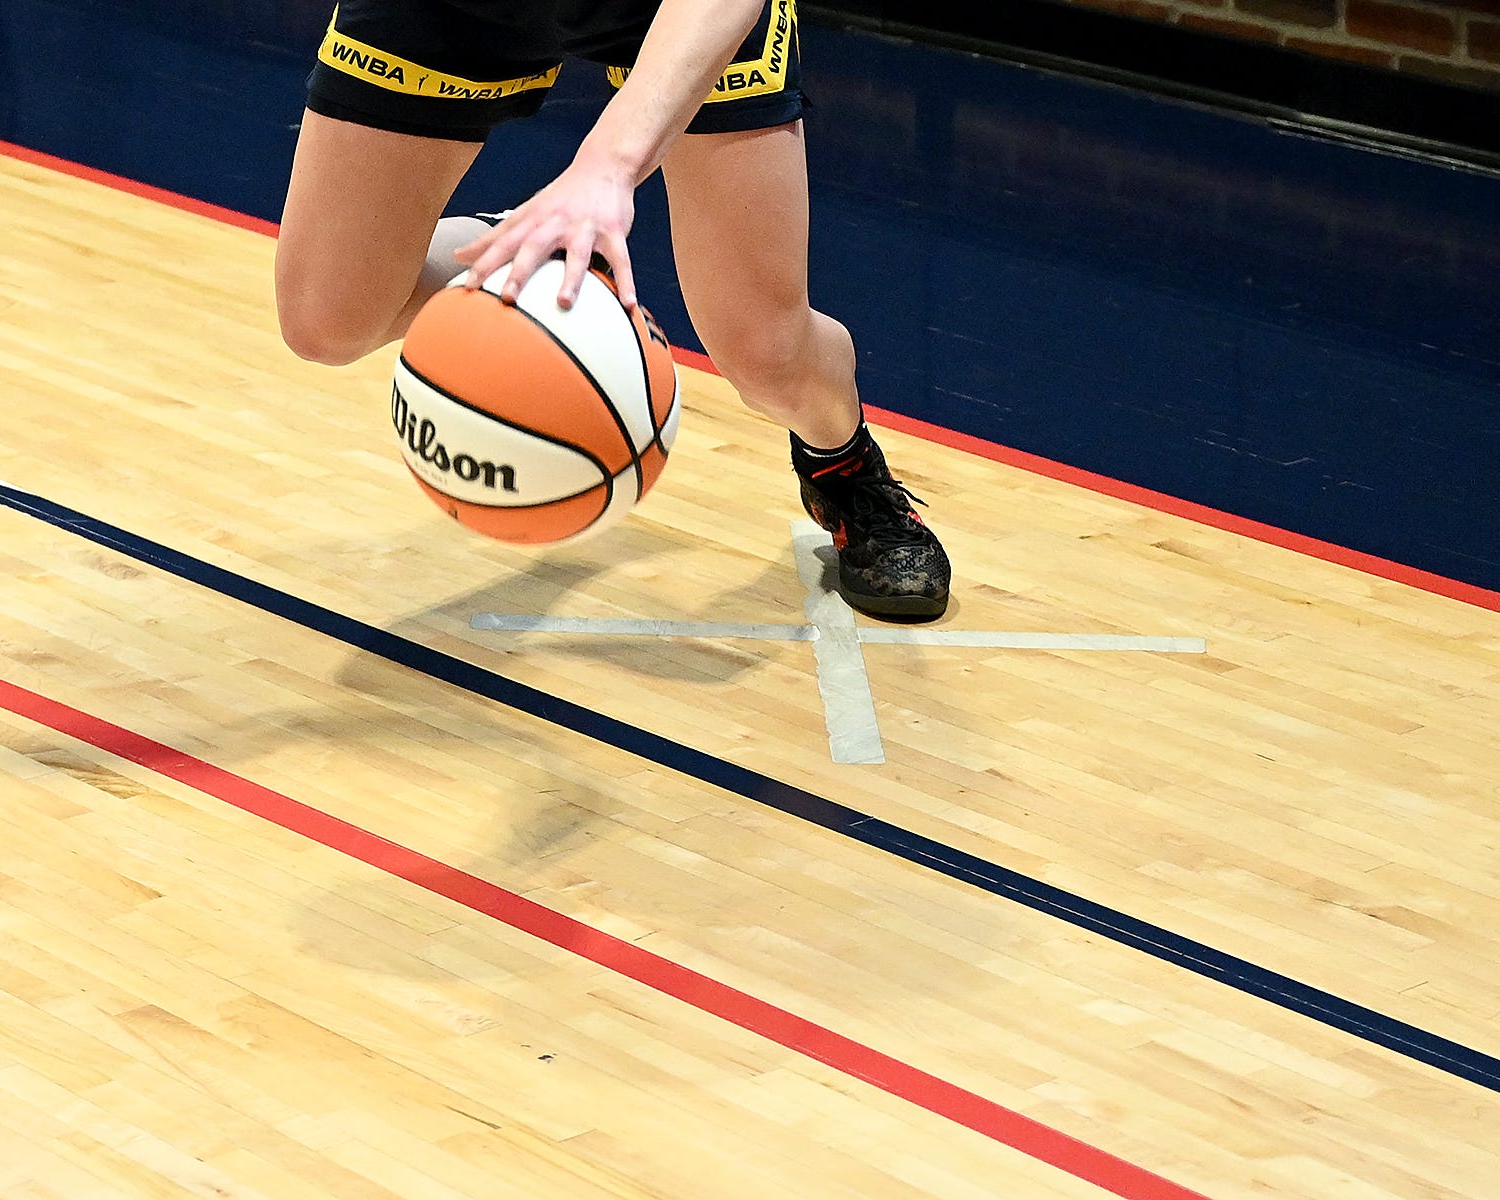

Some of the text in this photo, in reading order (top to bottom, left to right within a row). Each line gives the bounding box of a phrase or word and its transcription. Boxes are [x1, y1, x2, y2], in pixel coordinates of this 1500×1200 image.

[331, 41, 405, 85] WNBA
[768, 0, 789, 74] WNBA
[712, 69, 767, 92] NBA
[391, 376, 518, 493] Wilson
